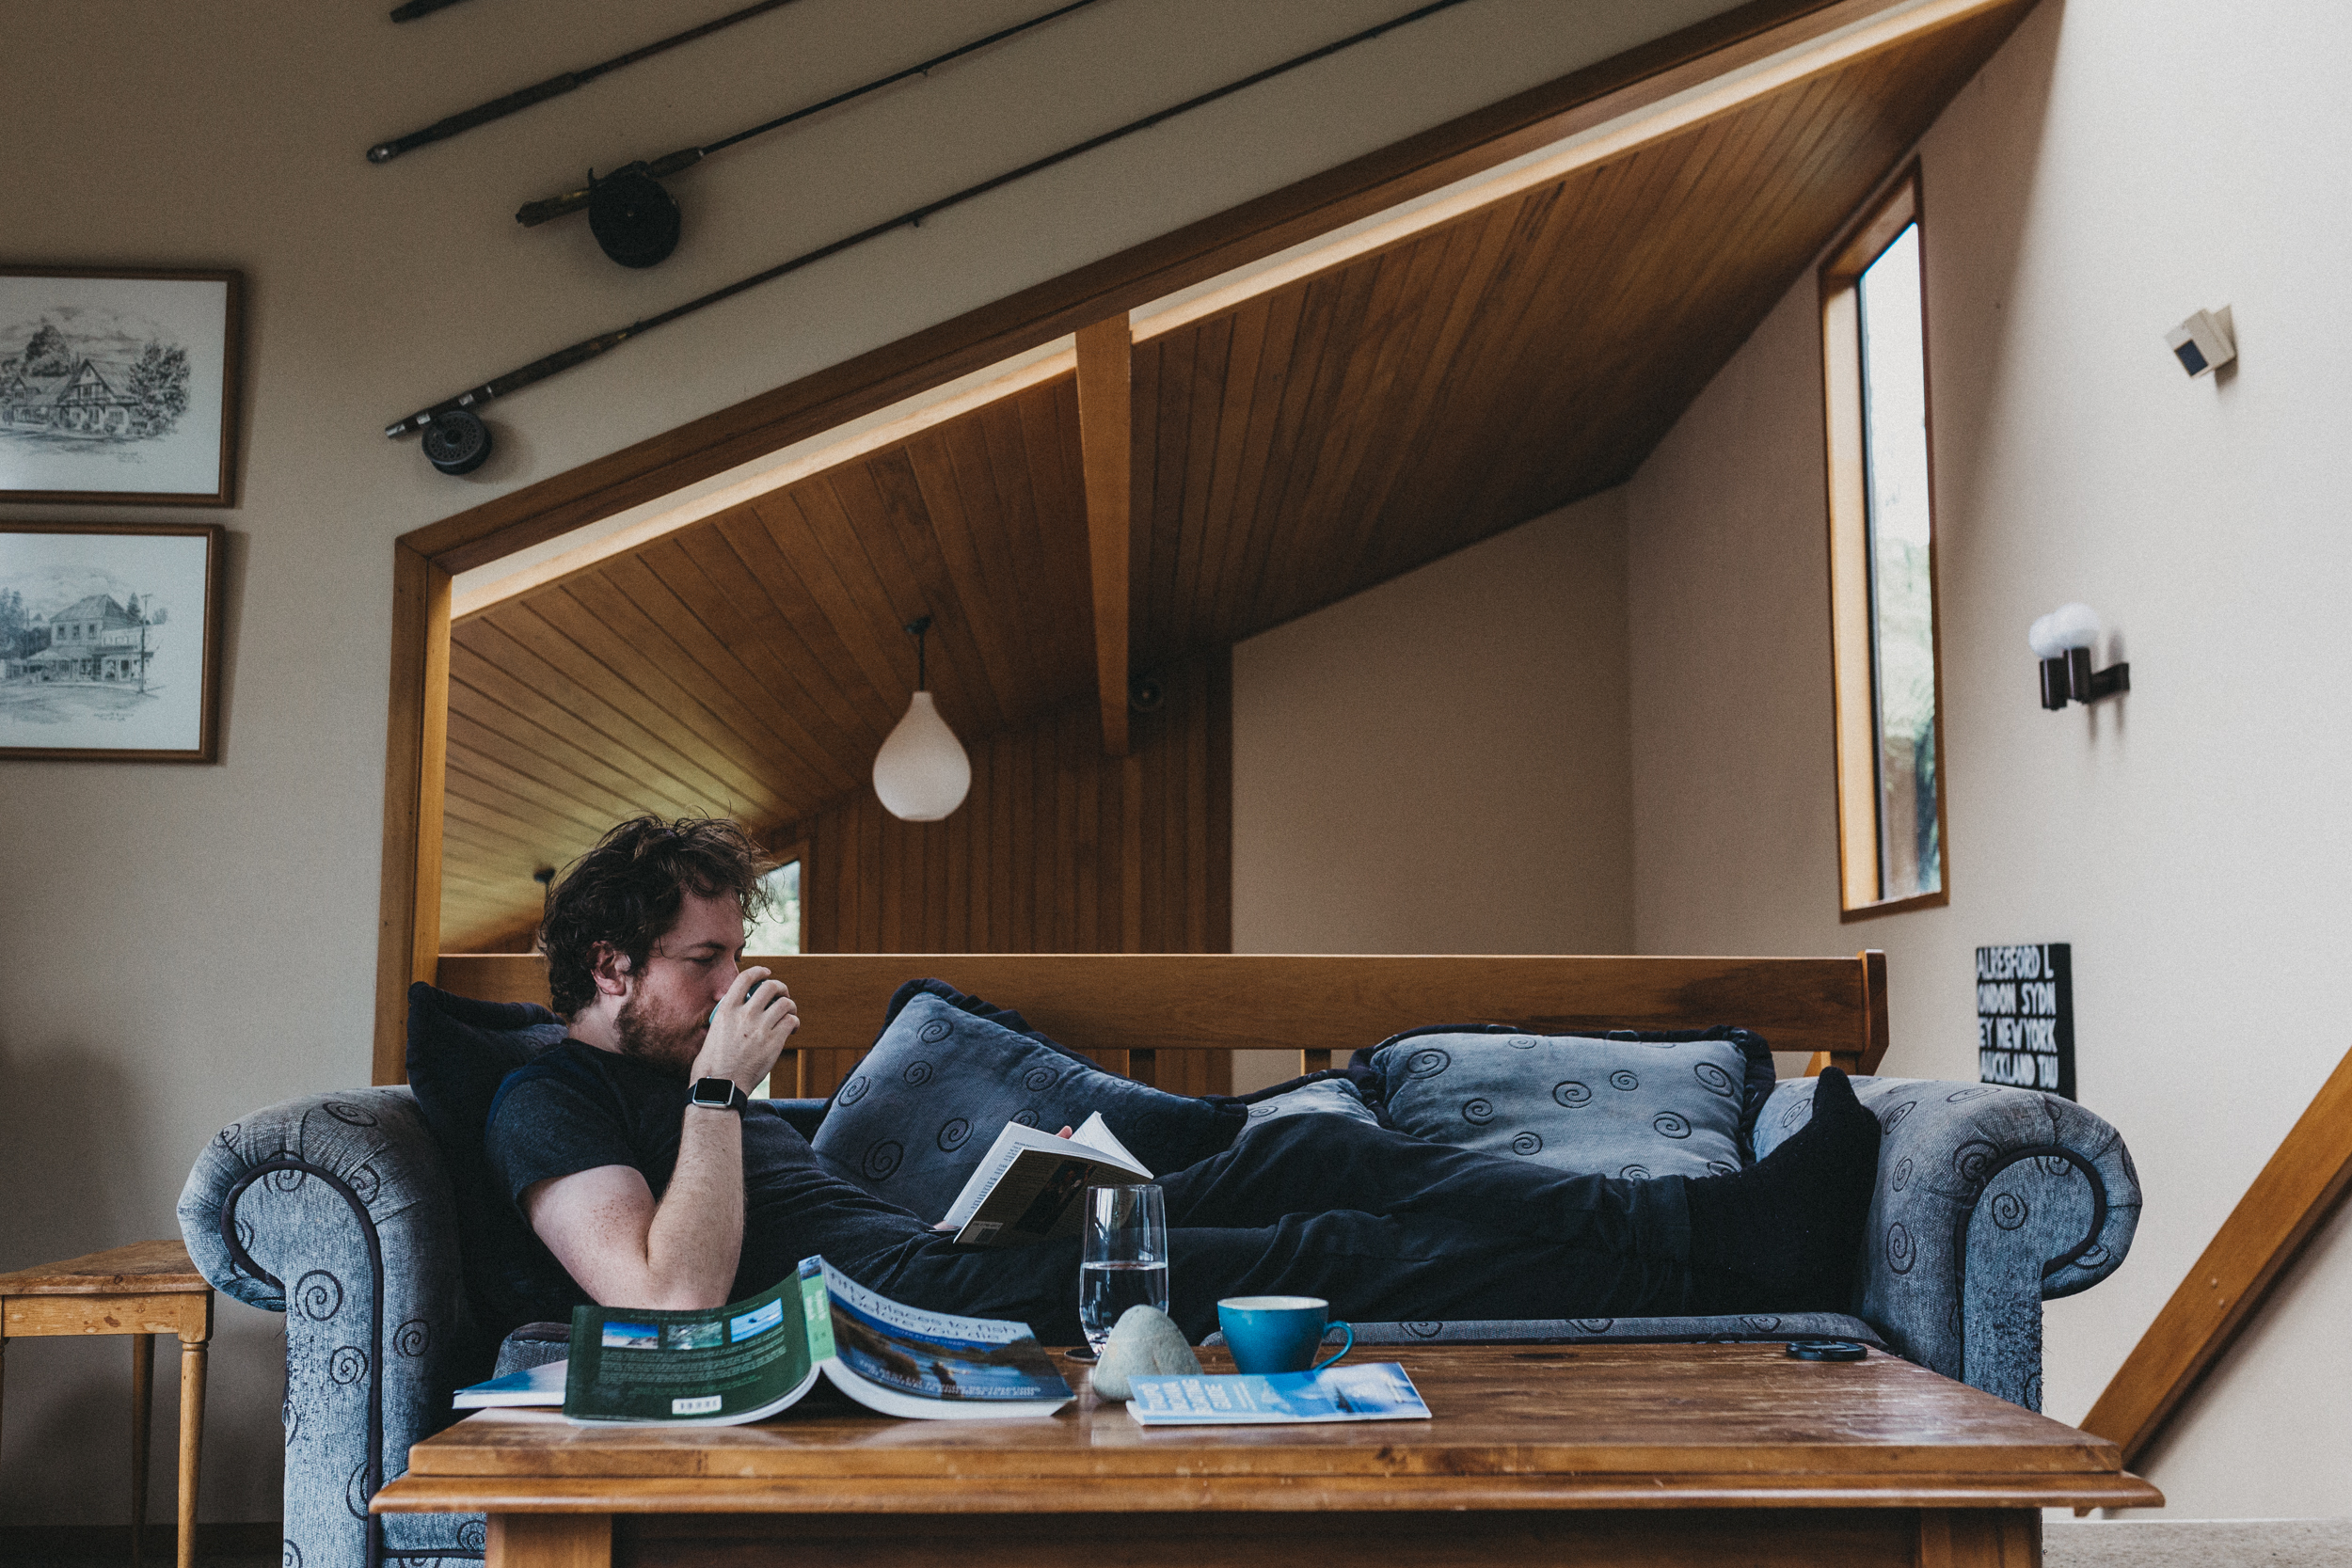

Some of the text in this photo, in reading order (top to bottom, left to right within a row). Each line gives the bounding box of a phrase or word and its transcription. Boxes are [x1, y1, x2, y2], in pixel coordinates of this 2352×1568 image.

[2043, 944, 2055, 979] L
[2021, 981, 2057, 1016] SYDN
[1979, 1017, 1993, 1047] EY
[850, 1294, 915, 1327] before
[923, 1325, 960, 1338] you
[968, 1331, 1000, 1340] die
[876, 1301, 943, 1327] places
[948, 1321, 969, 1330] to
[977, 1323, 1018, 1334] fish
